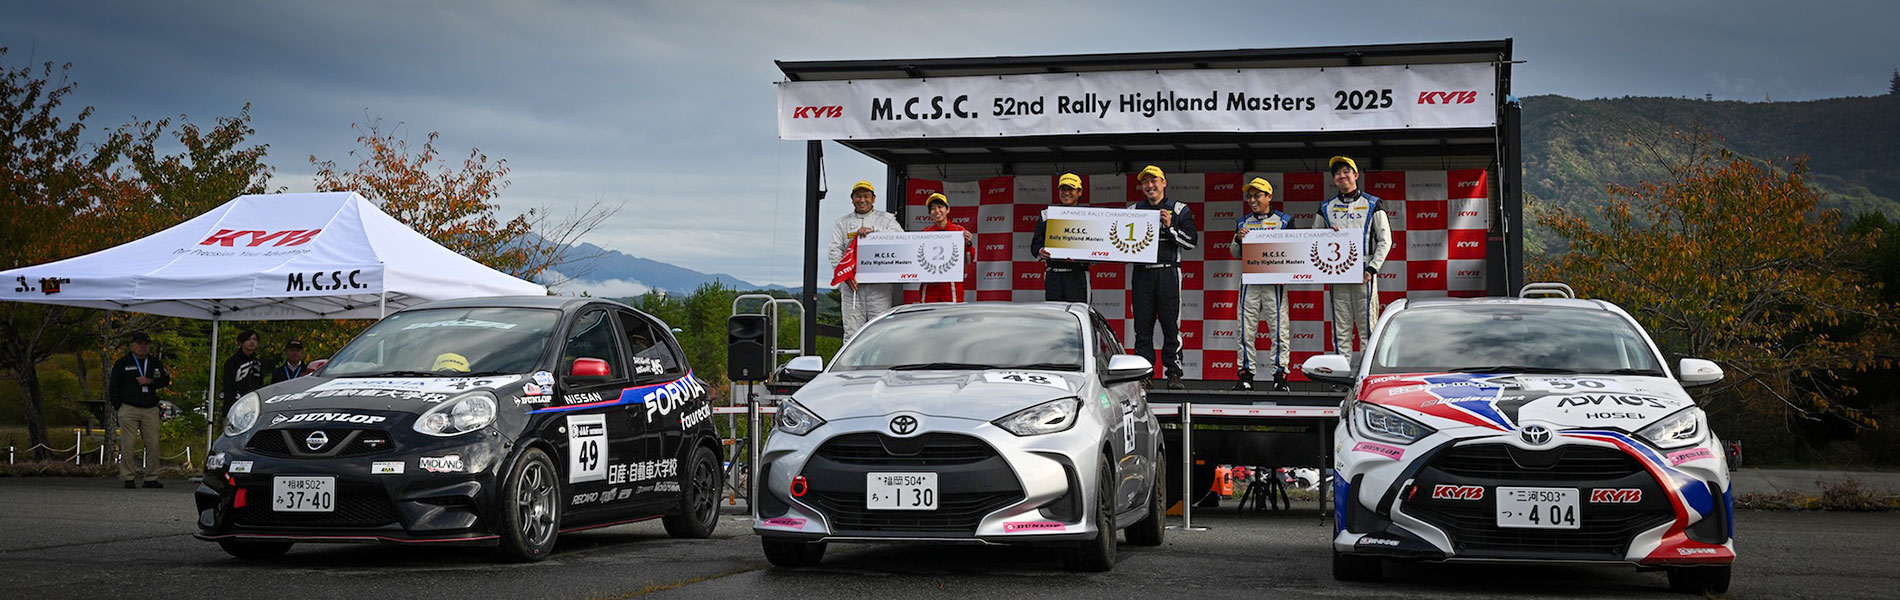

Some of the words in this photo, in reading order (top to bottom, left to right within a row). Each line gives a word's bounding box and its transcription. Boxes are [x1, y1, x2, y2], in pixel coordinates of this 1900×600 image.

[793, 105, 843, 119] KYB
[870, 94, 978, 121] M.C.S.C.
[992, 96, 1044, 116] 52nd
[1057, 93, 1112, 119] Rally
[1120, 90, 1218, 118] Highland
[1226, 91, 1316, 112] Masters
[1334, 88, 1393, 111] 2025
[1417, 90, 1477, 105] KYB
[199, 228, 322, 247] KYB
[1124, 222, 1137, 242] 1
[932, 245, 945, 260] 2
[1327, 242, 1341, 262] 3
[286, 269, 368, 292] M.C.S.C.
[520, 395, 552, 405] DUNLOP
[563, 392, 603, 405] NISSAN
[643, 373, 706, 424] FORVIA
[287, 412, 387, 424] DUNLOP
[578, 440, 599, 472] 49
[1363, 444, 1400, 456] DUNLOP
[421, 458, 463, 470] MIDLAND
[286, 491, 331, 510] 37-40
[1433, 485, 1484, 500] KYB
[1590, 488, 1643, 504] KYB
